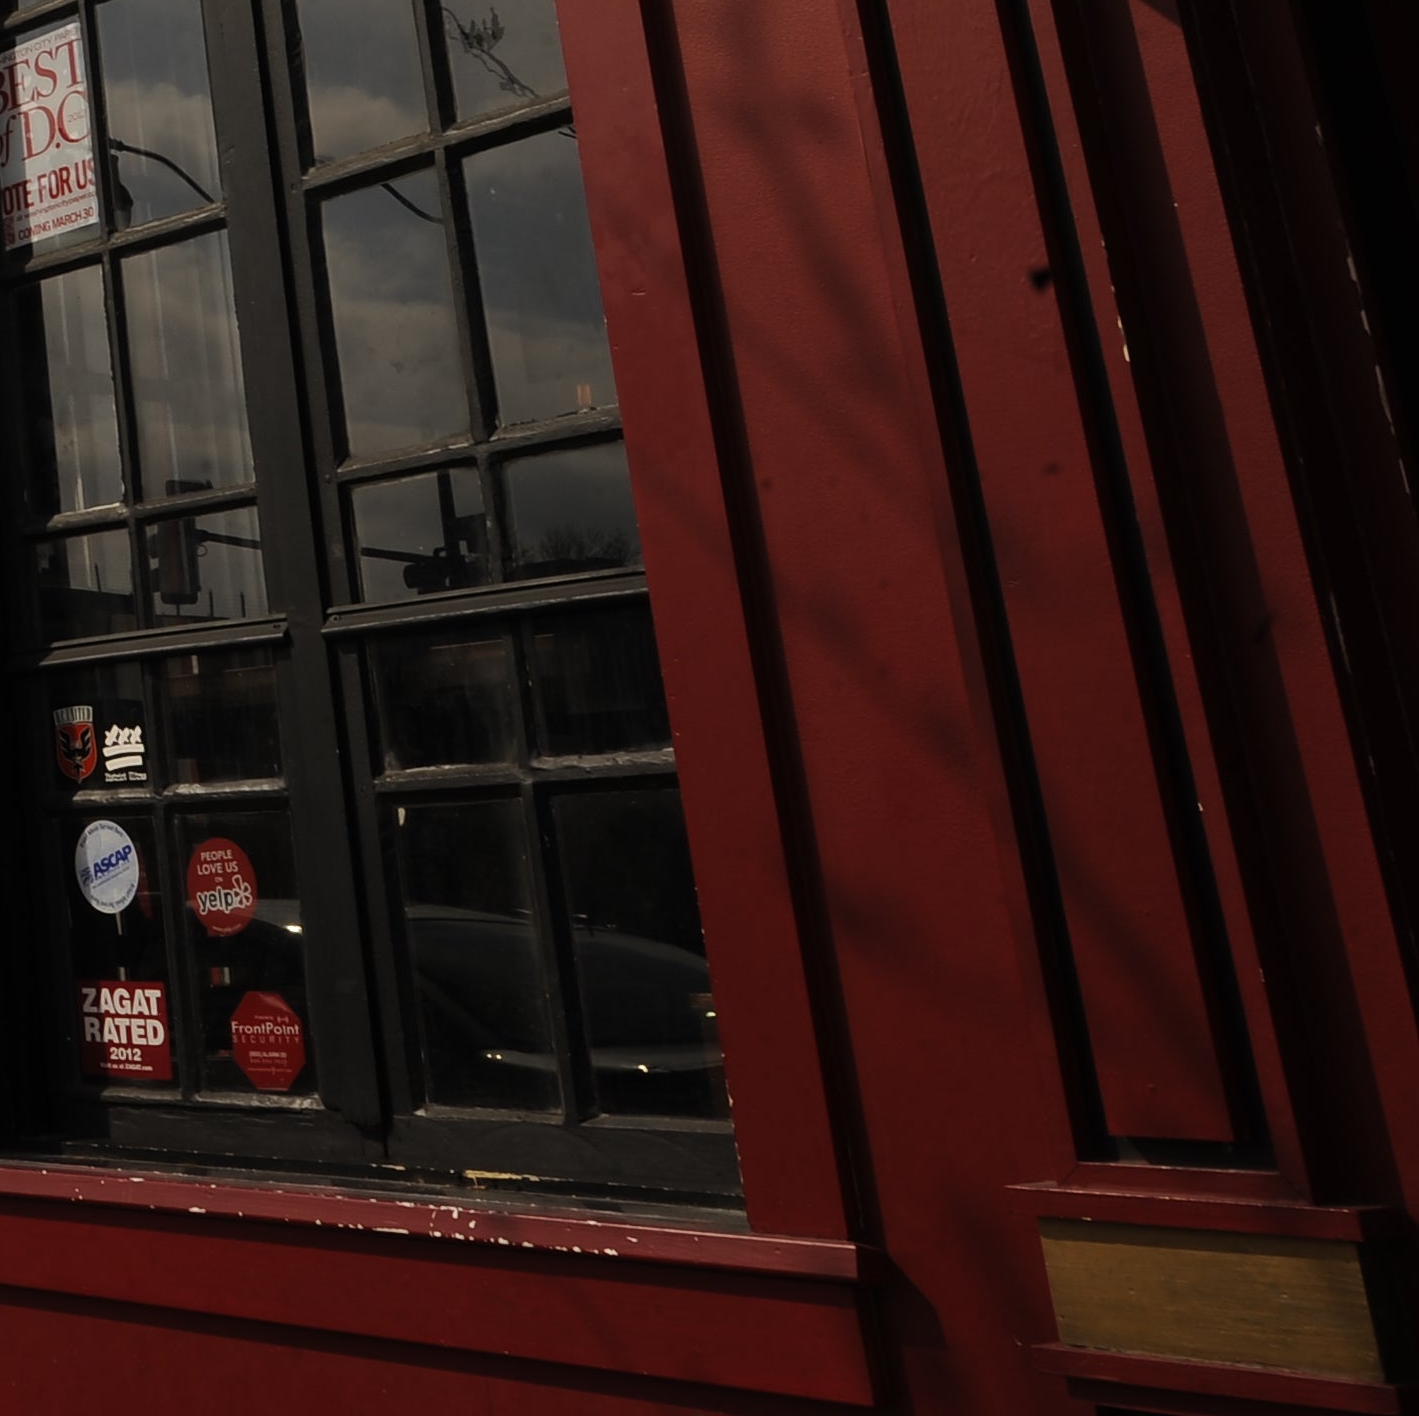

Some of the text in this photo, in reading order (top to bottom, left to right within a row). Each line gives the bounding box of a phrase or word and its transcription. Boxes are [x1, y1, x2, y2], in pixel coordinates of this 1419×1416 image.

[2, 179, 34, 216] OTE
[37, 165, 72, 203] FOR
[18, 220, 51, 240] COMING
[52, 210, 82, 229] MARCH
[83, 206, 94, 220] 30
[93, 845, 132, 878] ASCAP
[196, 861, 239, 875] LOVE US
[200, 849, 233, 862] PEOPLE
[196, 886, 235, 915] yelp
[82, 987, 162, 1016] ZAGAT
[83, 1016, 165, 1046] RATED
[231, 1020, 299, 1035] FrontPoint
[232, 1035, 299, 1044] SECURITY
[109, 1047, 143, 1062] 2012
